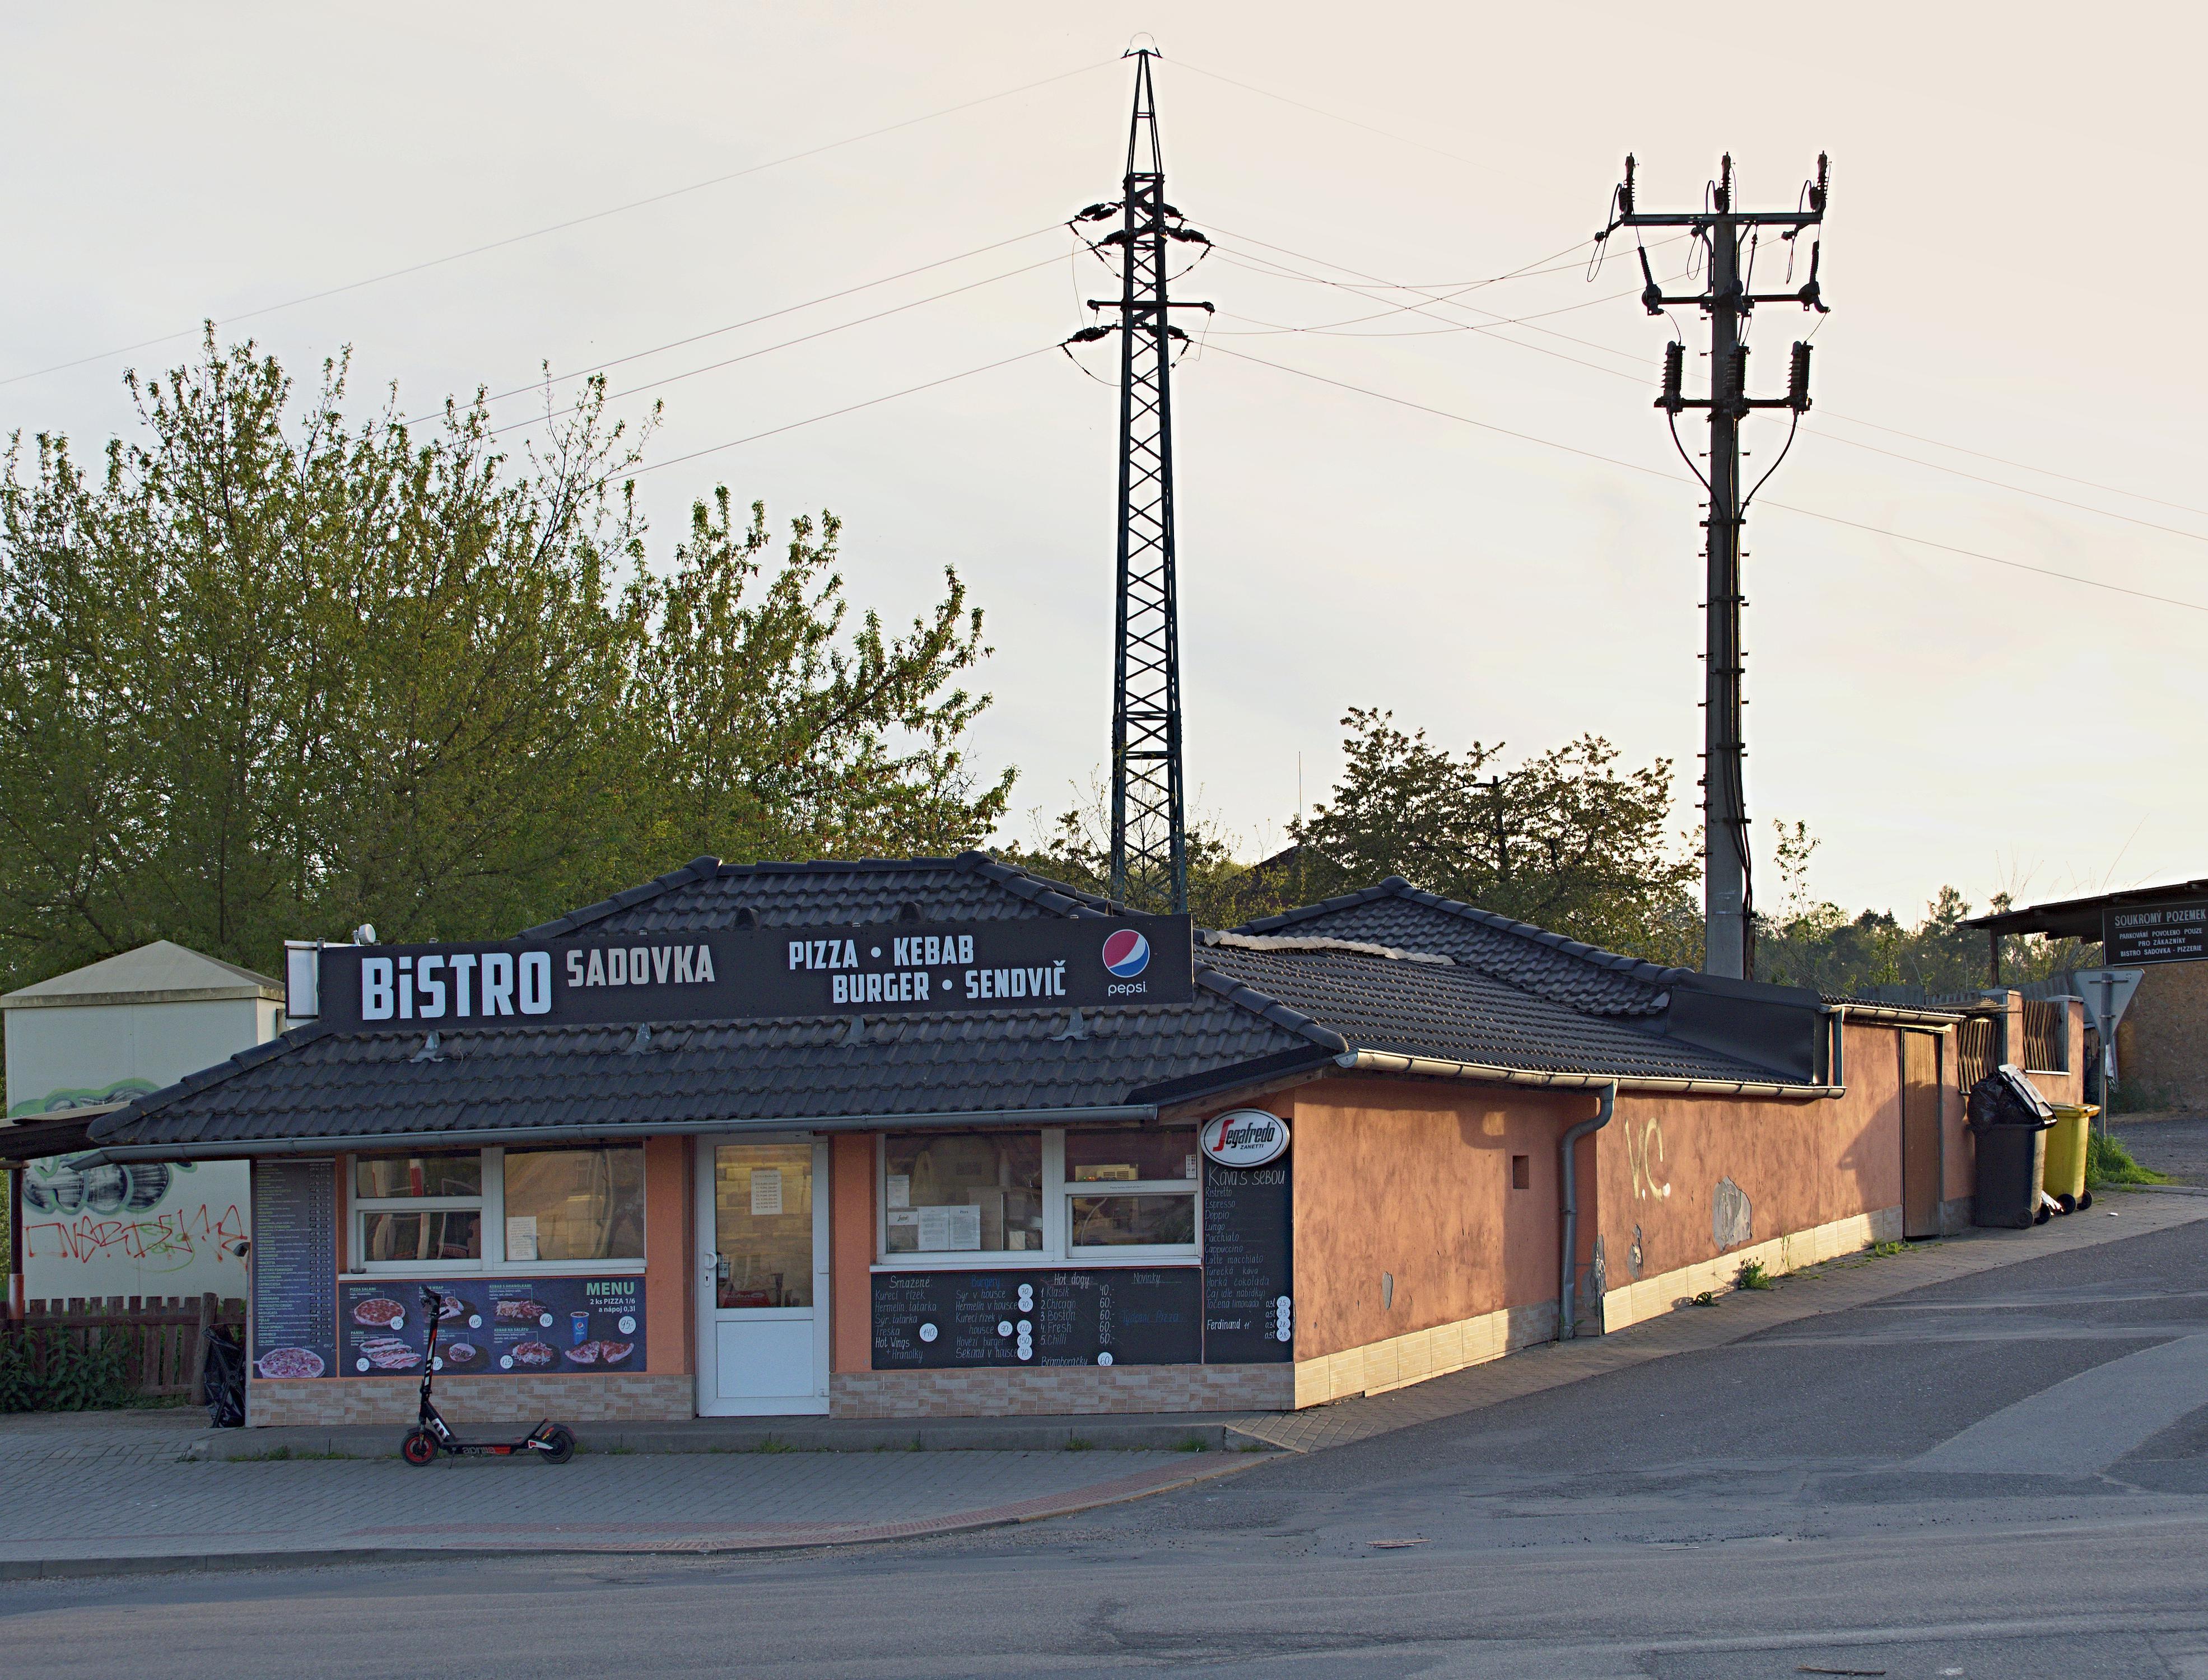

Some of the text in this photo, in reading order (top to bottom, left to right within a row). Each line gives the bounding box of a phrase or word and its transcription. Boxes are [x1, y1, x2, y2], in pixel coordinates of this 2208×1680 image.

[2114, 909, 2206, 926] SOUKROMÝ POZEMEK
[2120, 931, 2148, 940] PARKOVÁNÍ
[2153, 937, 2186, 946] ZÁKAZNÍKY
[789, 935, 973, 970] PIZZA KEBAB
[2144, 947, 2170, 955] SADOVKA
[567, 945, 715, 987] SADOVKA
[832, 960, 1066, 1003] BURGER SENDVIČ
[1108, 981, 1145, 996] pepsi
[1213, 1119, 1275, 1152] Segafredo
[1209, 1166, 1237, 1186] Káva
[1205, 1187, 1232, 1197] Ristretto
[1205, 1198, 1235, 1210] Espresso
[1205, 1210, 1229, 1221] Doppio
[1204, 1221, 1226, 1234] Lungo
[1204, 1231, 1239, 1242] Macchiato
[1205, 1245, 1243, 1256] Cappuccino
[1205, 1254, 1264, 1264] Latte macchiato
[1206, 1266, 1233, 1276] Turecká
[971, 1275, 1000, 1290] Burgery
[1054, 1273, 1066, 1285] Hot
[1134, 1272, 1161, 1287] Novinky
[1207, 1276, 1269, 1287] Horká čokoláda
[586, 1282, 635, 1295] MENU
[981, 1289, 1006, 1299] housce
[1046, 1286, 1069, 1297] Klasik
[1206, 1287, 1218, 1299] Čaj
[875, 1289, 898, 1300] Kuřecí
[909, 1301, 937, 1312] tatarka
[994, 1300, 1018, 1310] housce
[1047, 1299, 1075, 1312] Chicago
[1207, 1299, 1229, 1309] Točená
[893, 1314, 917, 1323] tatarka
[1047, 1310, 1075, 1321] Boston
[968, 1325, 994, 1334] housce
[1048, 1321, 1072, 1333] Fresh
[1207, 1318, 1241, 1330] Ferdinand
[875, 1326, 900, 1336] Treska
[875, 1337, 910, 1350] Hot Wings
[983, 1336, 1006, 1349] burger
[1047, 1334, 1066, 1345] Chilli
[892, 1348, 923, 1363] Hranolky
[956, 1347, 1018, 1359] Sekaná v housce
